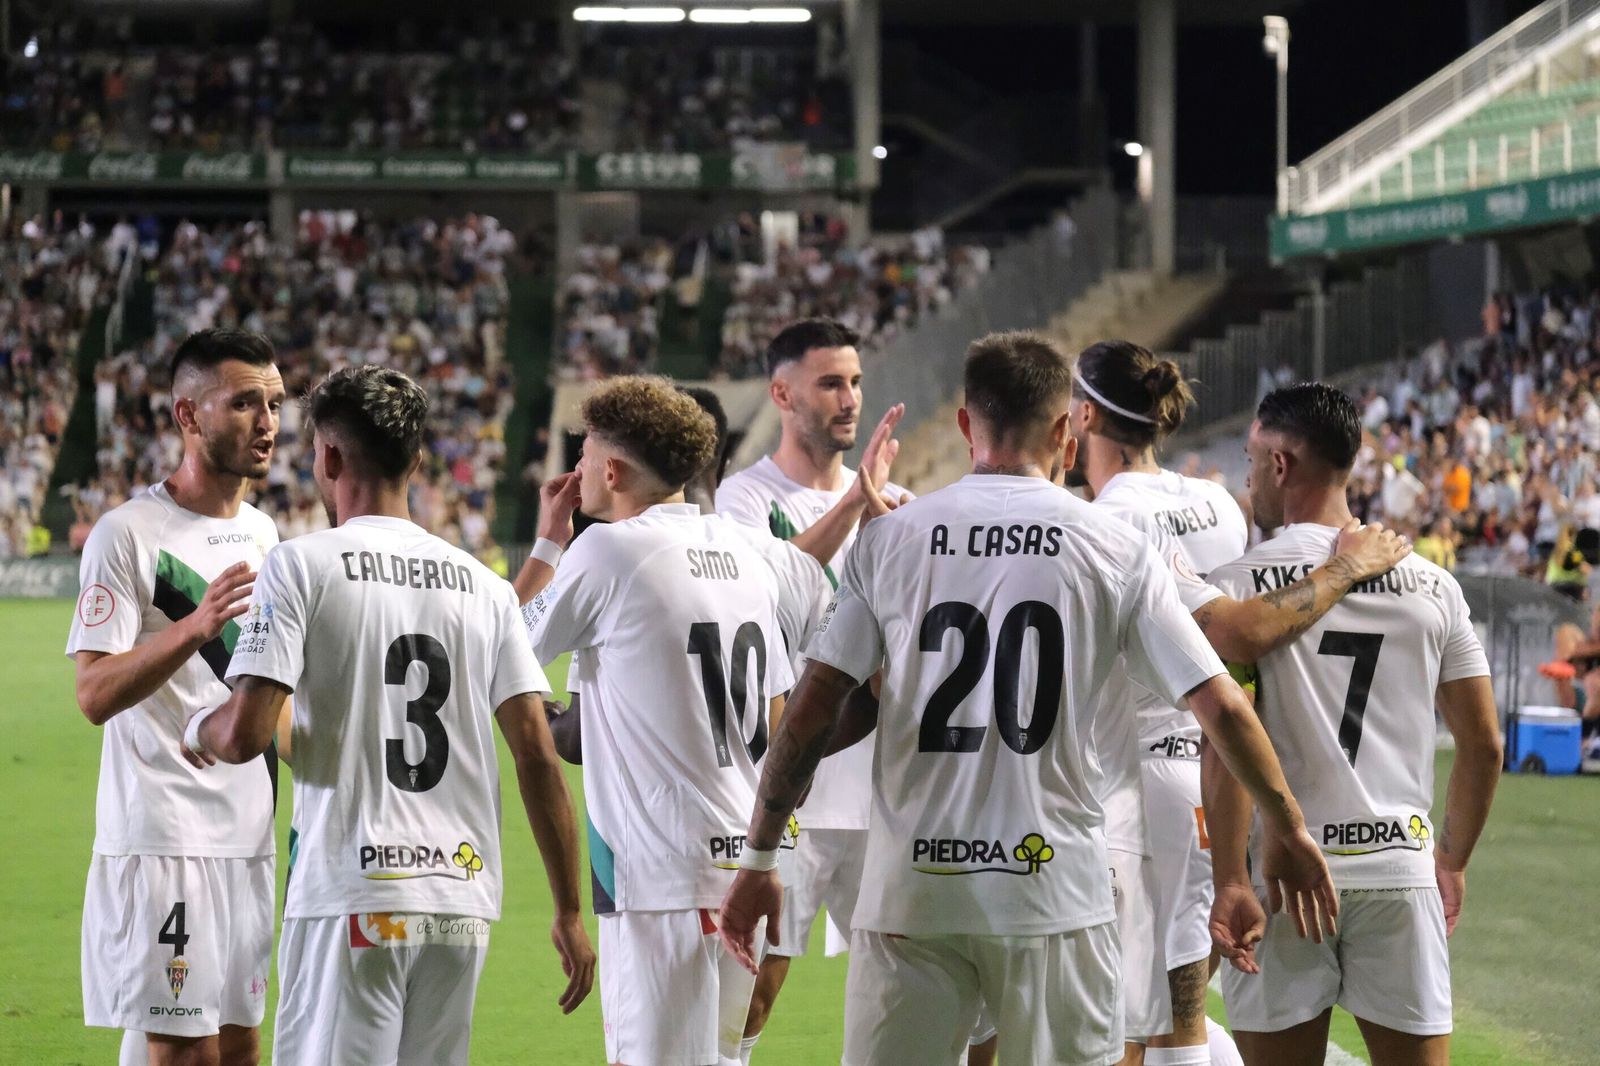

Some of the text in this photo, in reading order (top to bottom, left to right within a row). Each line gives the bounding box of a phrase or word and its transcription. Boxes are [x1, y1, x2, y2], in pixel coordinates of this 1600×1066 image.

[687, 548, 739, 580] SIMO
[931, 525, 1063, 557] A. CASAS
[341, 551, 474, 594] CALDERÓN
[687, 621, 769, 768] 10
[919, 600, 1065, 755] 20
[1317, 630, 1384, 769] 7
[385, 634, 451, 792] 3
[158, 902, 190, 956] 4
[417, 919, 433, 934] de
[150, 1006, 202, 1016] GIVOVA
